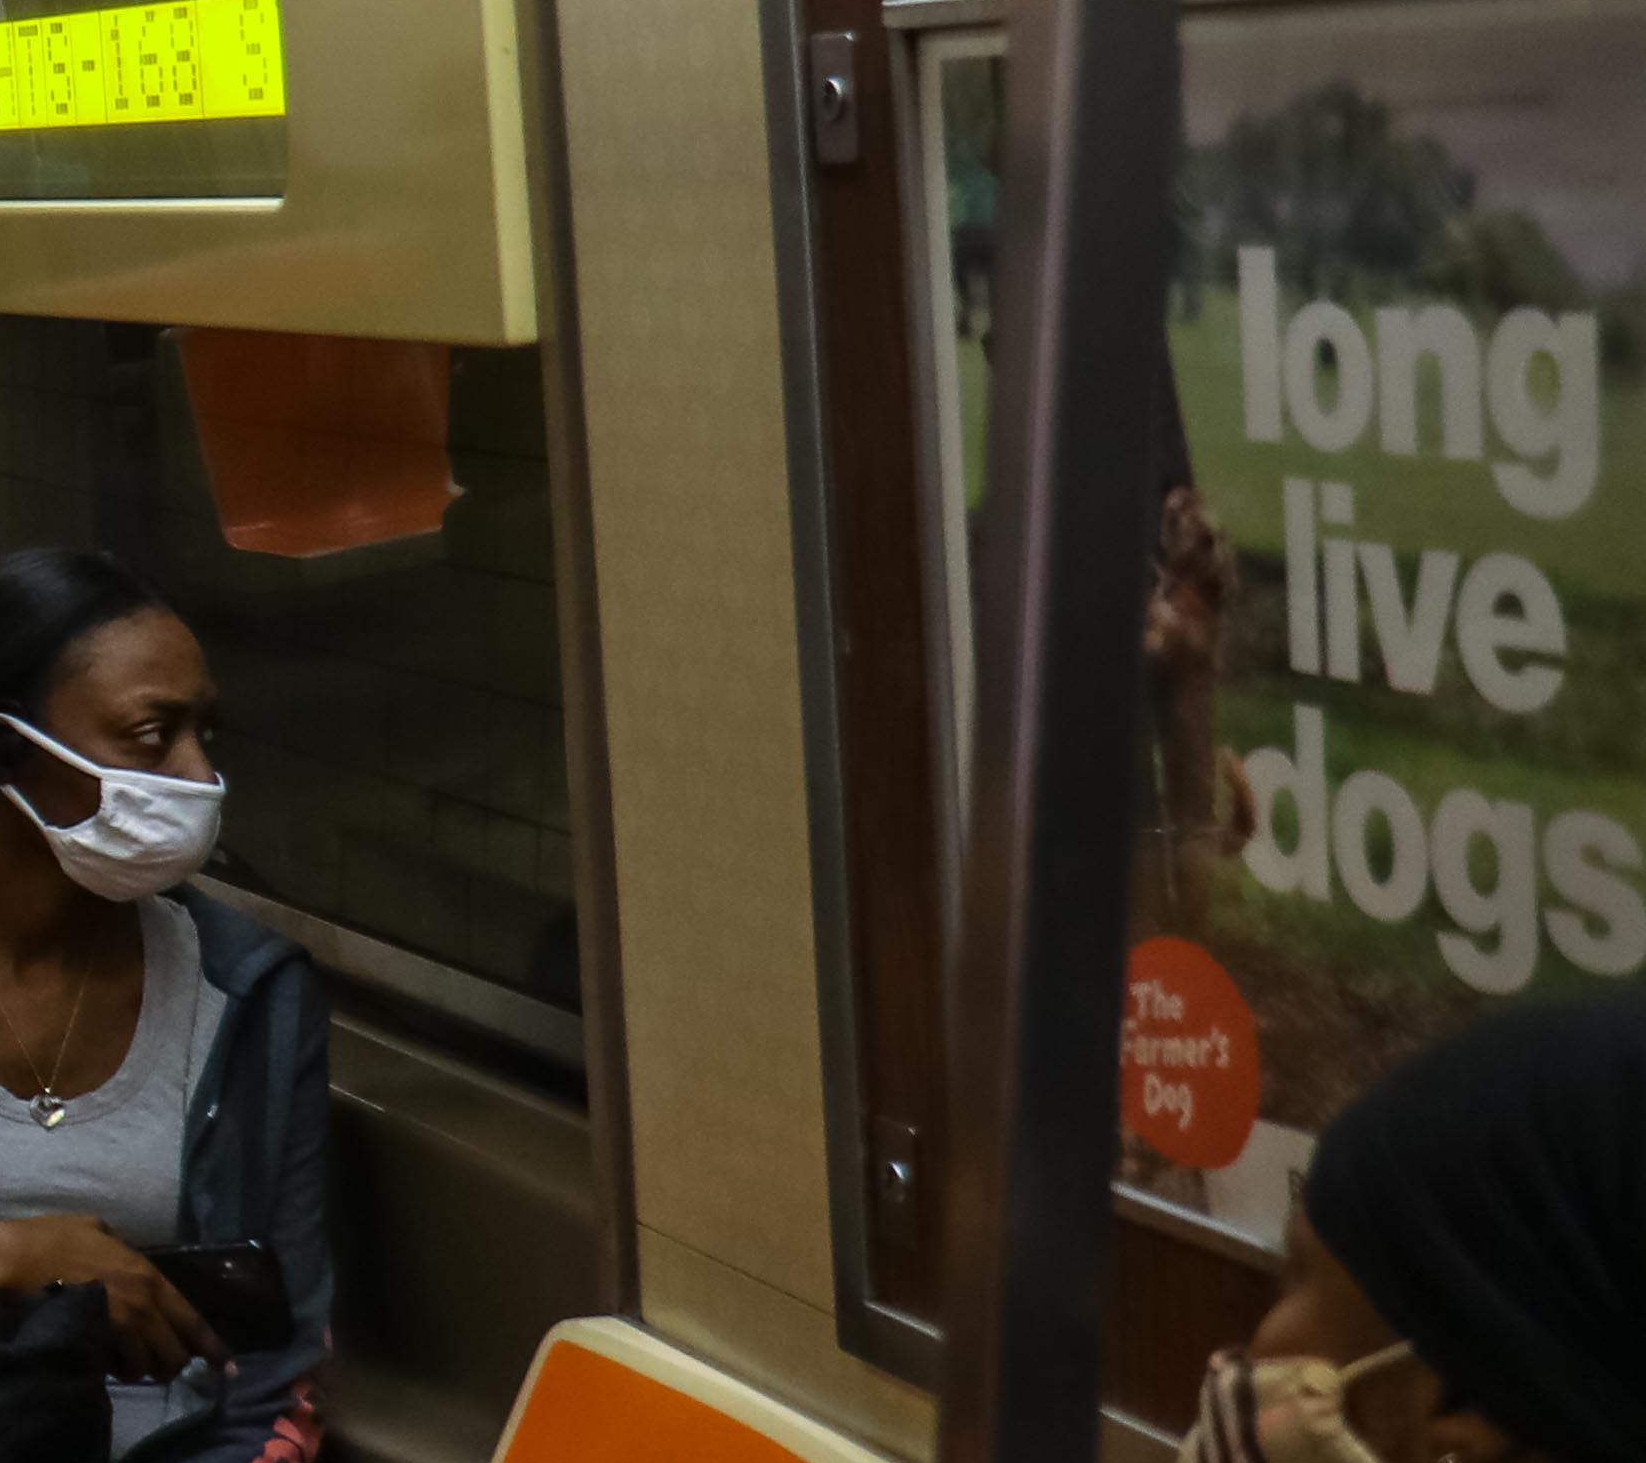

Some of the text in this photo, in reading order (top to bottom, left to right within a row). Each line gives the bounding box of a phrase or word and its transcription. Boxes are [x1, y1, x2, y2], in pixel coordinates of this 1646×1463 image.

[1237, 244, 1602, 520] long
[1283, 474, 1568, 716] live
[1241, 702, 1646, 995] dogs
[1120, 1017, 1231, 1070] Farmer's
[1129, 979, 1185, 1022] The
[1142, 1072, 1194, 1131] Dog
